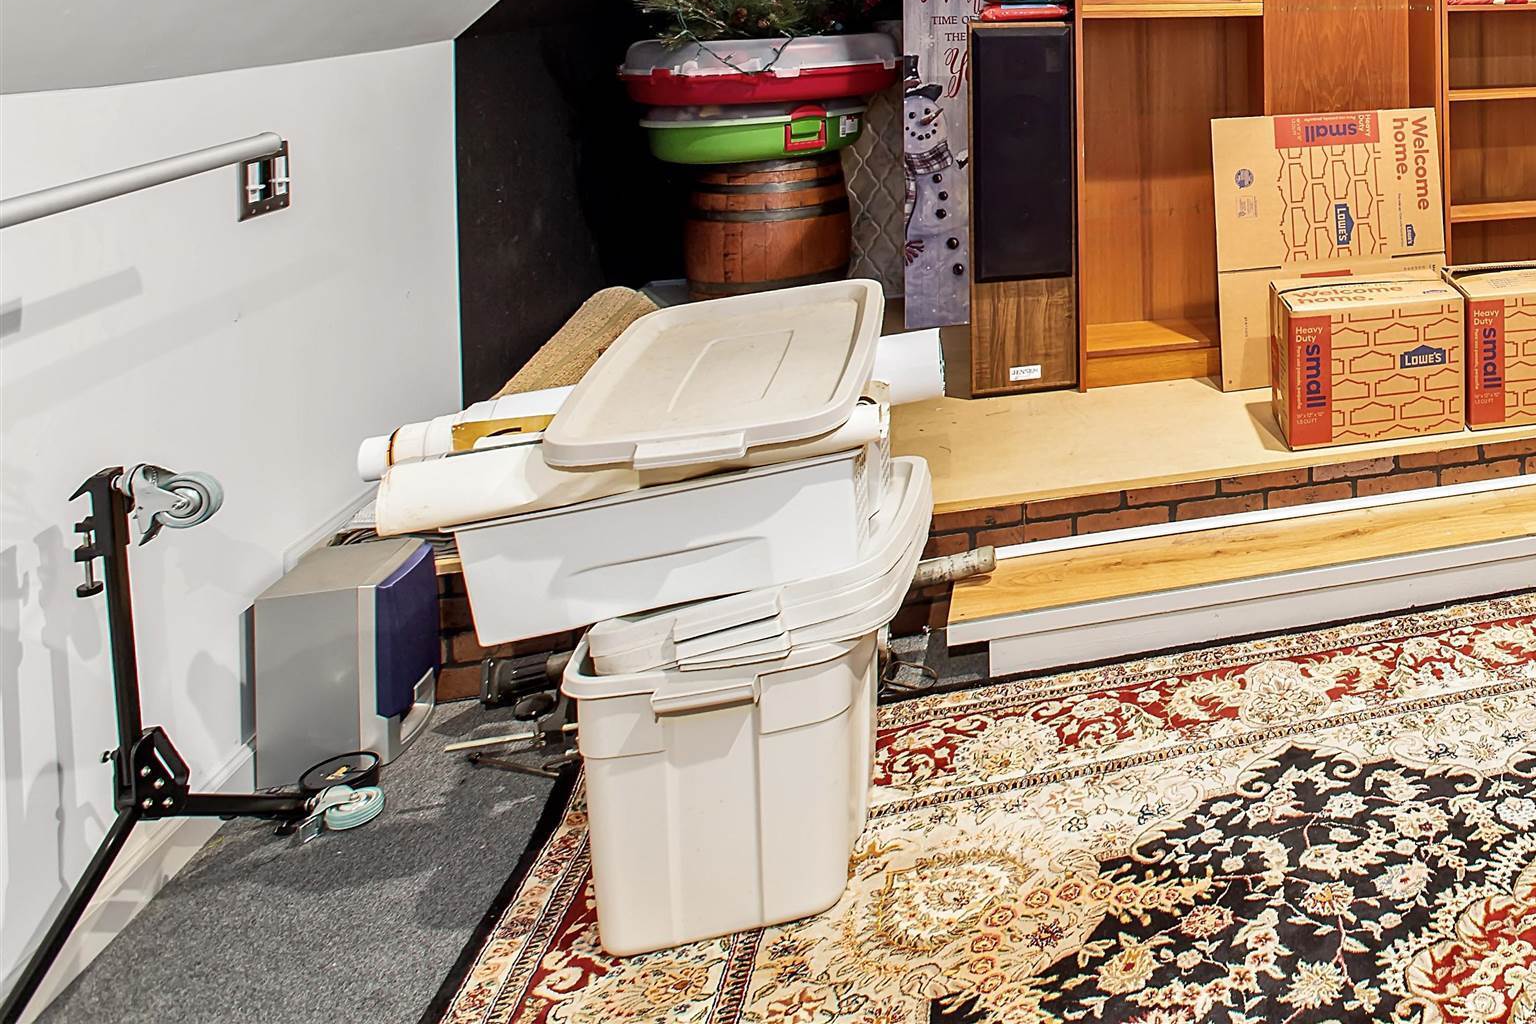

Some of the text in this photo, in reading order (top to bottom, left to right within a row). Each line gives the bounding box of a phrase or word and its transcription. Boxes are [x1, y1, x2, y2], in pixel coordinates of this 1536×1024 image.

[931, 16, 958, 25] TIME
[945, 32, 966, 42] THE
[1304, 123, 1358, 143] small
[1392, 117, 1409, 181] home.
[1411, 116, 1430, 211] Welcome
[1336, 207, 1347, 242] LOWE'S
[1473, 309, 1499, 318] Heavy
[1473, 317, 1493, 326] Duty
[1295, 326, 1323, 336] Heavy
[1295, 334, 1317, 343] Duty
[1404, 352, 1442, 366] LOWE'S
[1483, 328, 1502, 389] small
[1306, 344, 1326, 408] small
